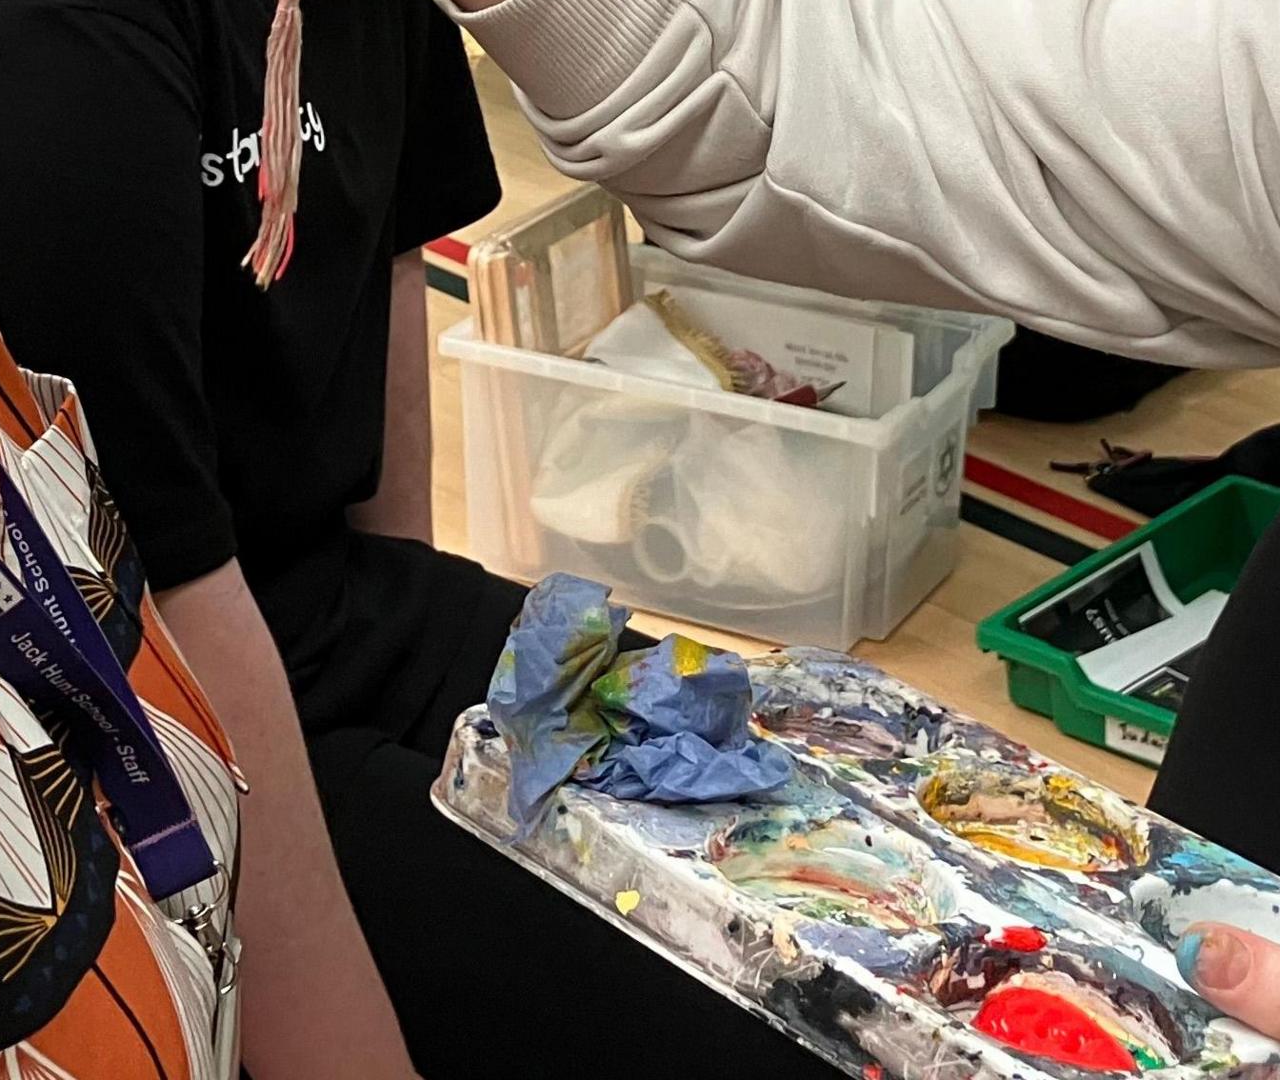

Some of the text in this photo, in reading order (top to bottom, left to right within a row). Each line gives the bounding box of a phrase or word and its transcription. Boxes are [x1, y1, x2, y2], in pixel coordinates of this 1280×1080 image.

[8, 522, 50, 594] School
[9, 631, 48, 670] Jack
[39, 661, 78, 704] Hunt
[70, 691, 111, 739] School
[115, 745, 150, 786] Staff
